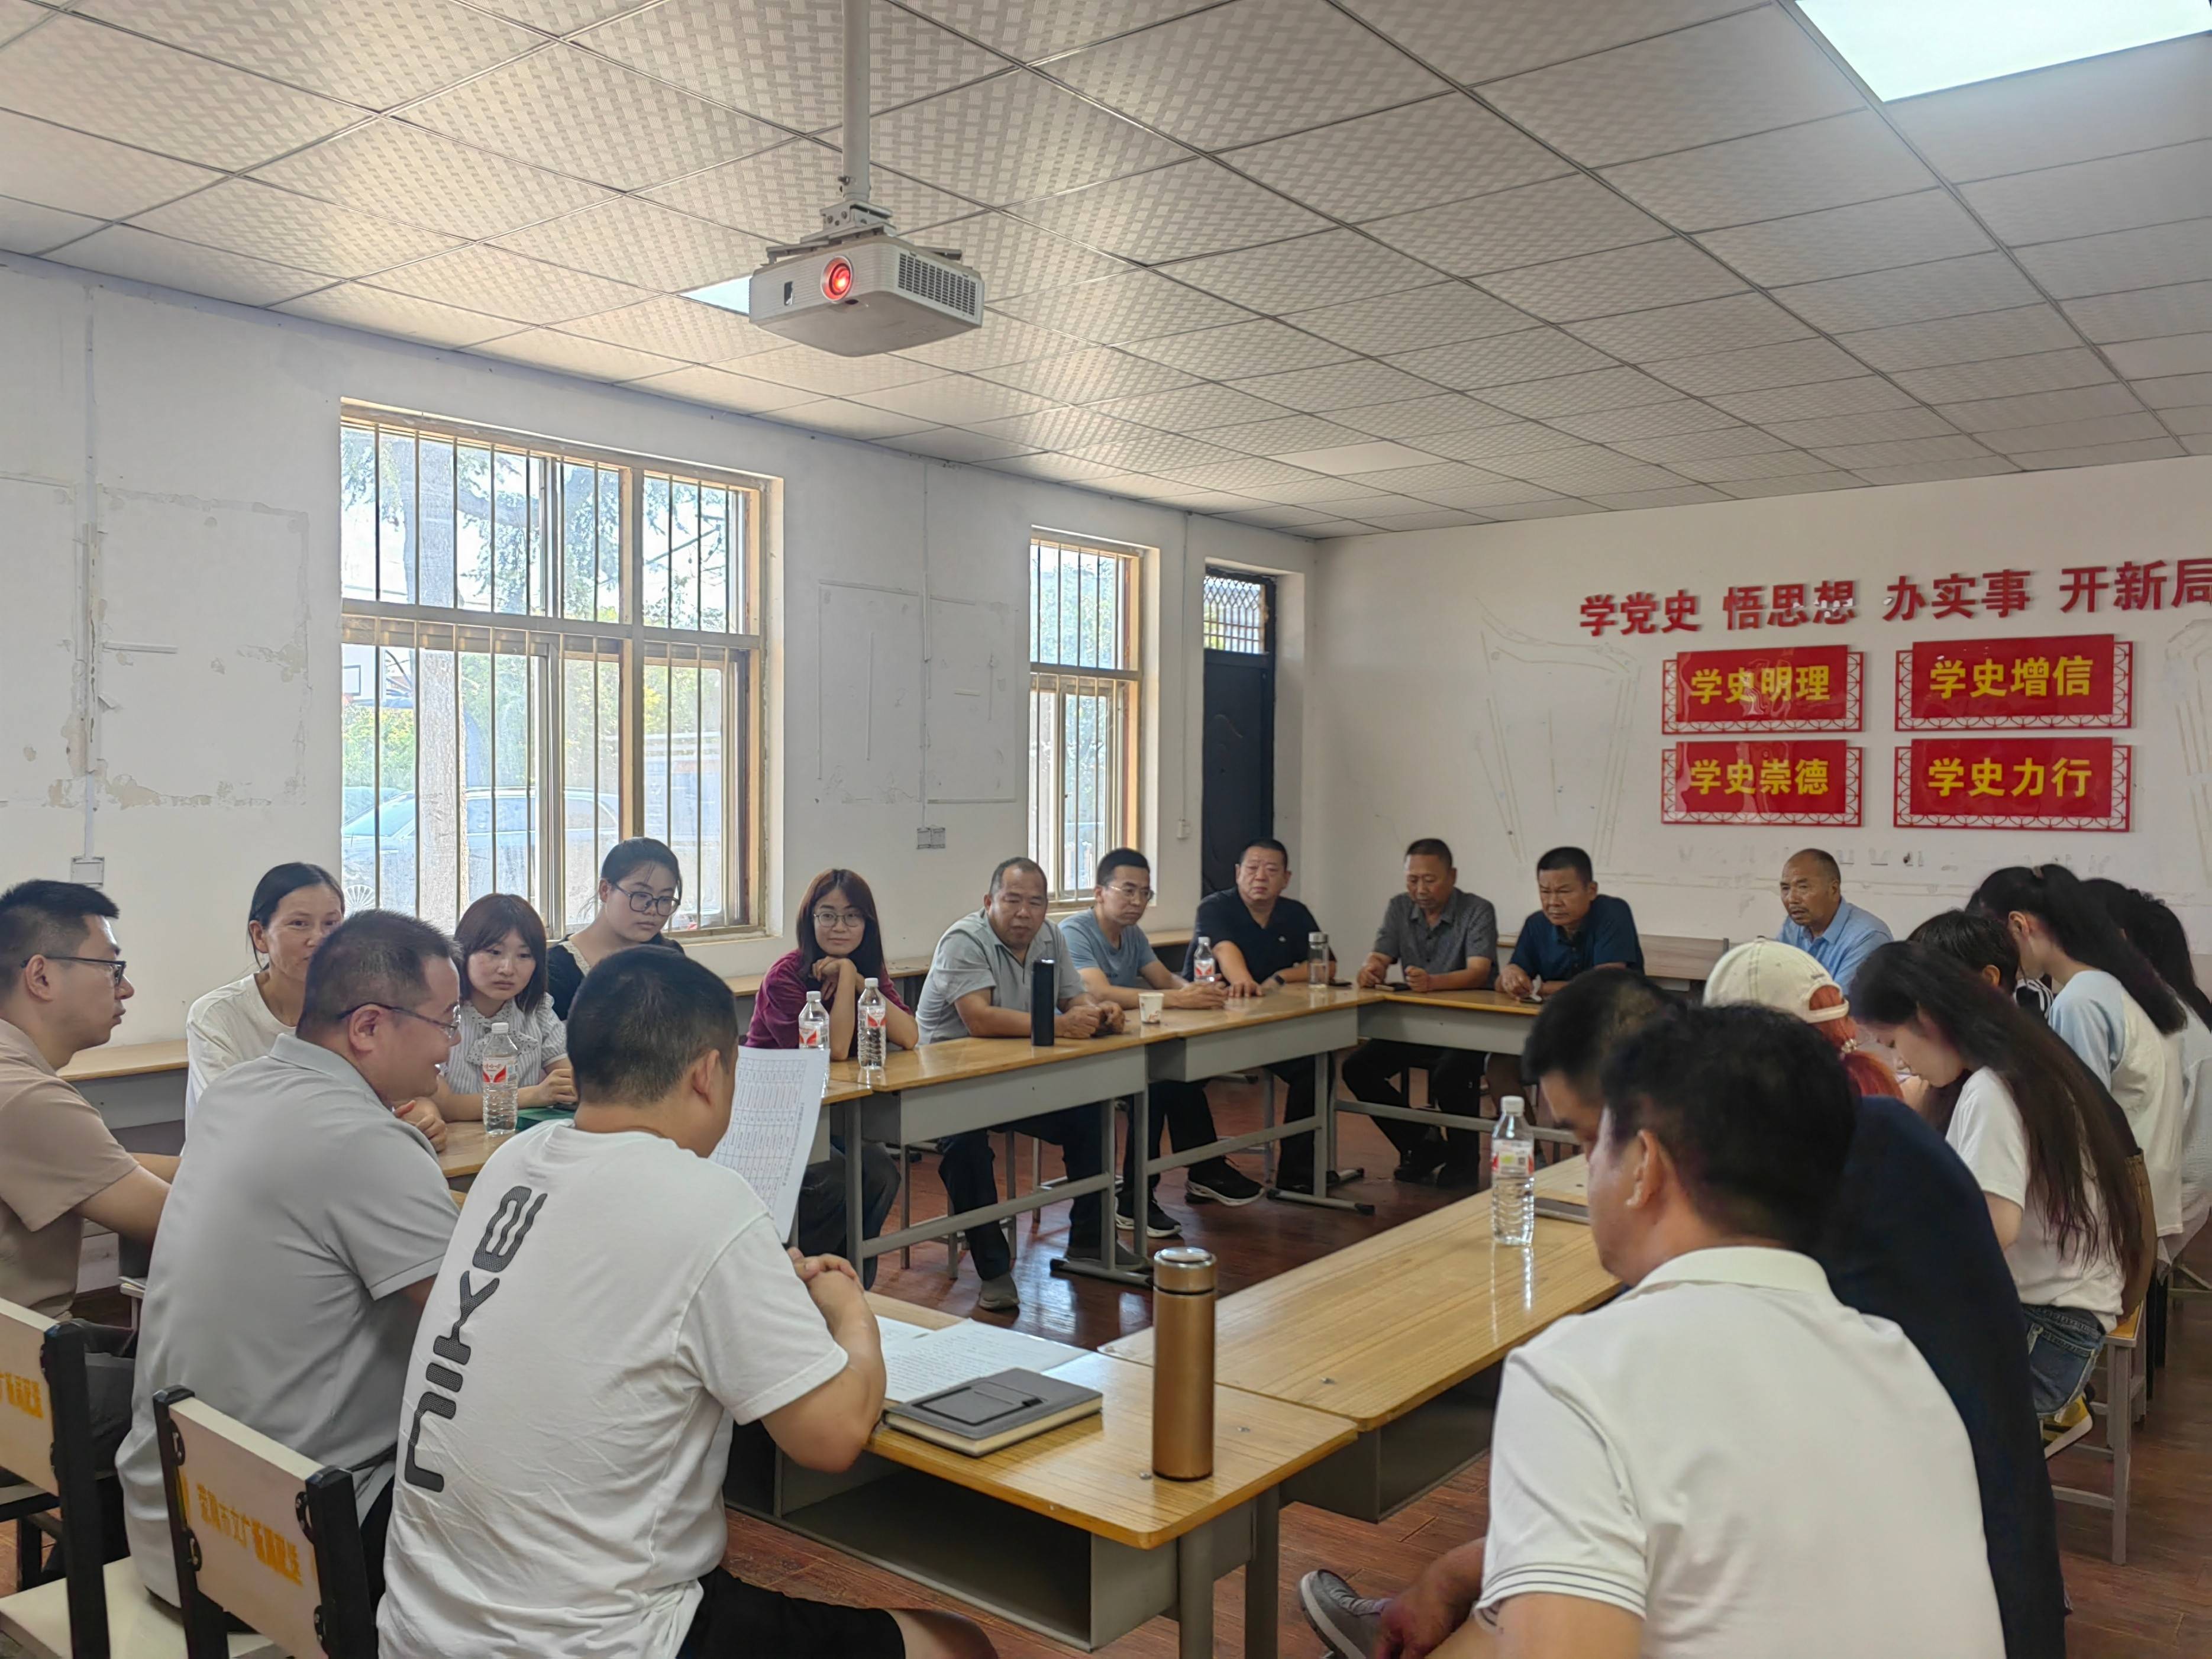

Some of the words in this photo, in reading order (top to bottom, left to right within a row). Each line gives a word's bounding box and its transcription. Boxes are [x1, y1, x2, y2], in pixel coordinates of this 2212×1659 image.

[1580, 590, 1701, 637] 学党史
[1722, 580, 1856, 630] 悟思想
[1883, 569, 2031, 621] 办实事
[2059, 557, 2212, 614] 开新局
[1690, 666, 1830, 705] 学史明理
[1929, 655, 2093, 699] 学史增信
[1690, 758, 1829, 795] 学史崇德
[1927, 757, 2092, 798] 学史力行
